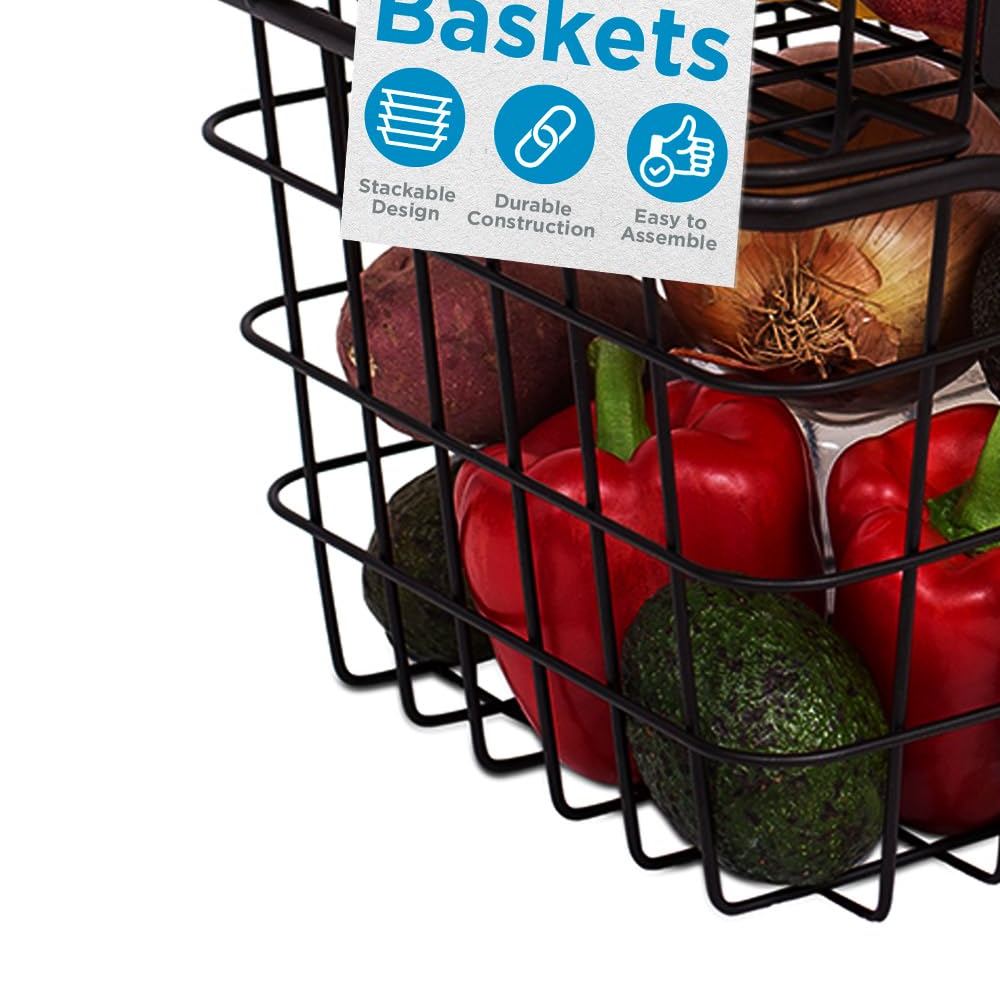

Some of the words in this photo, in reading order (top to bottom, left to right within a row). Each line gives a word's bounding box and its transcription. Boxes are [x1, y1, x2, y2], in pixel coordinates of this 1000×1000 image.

[359, 178, 456, 203] Stackable
[371, 199, 440, 222] Design
[494, 193, 572, 217] Durable
[467, 210, 596, 239] Construction
[634, 208, 681, 231] Easy
[686, 214, 707, 230] to
[621, 226, 718, 251] Assemble
